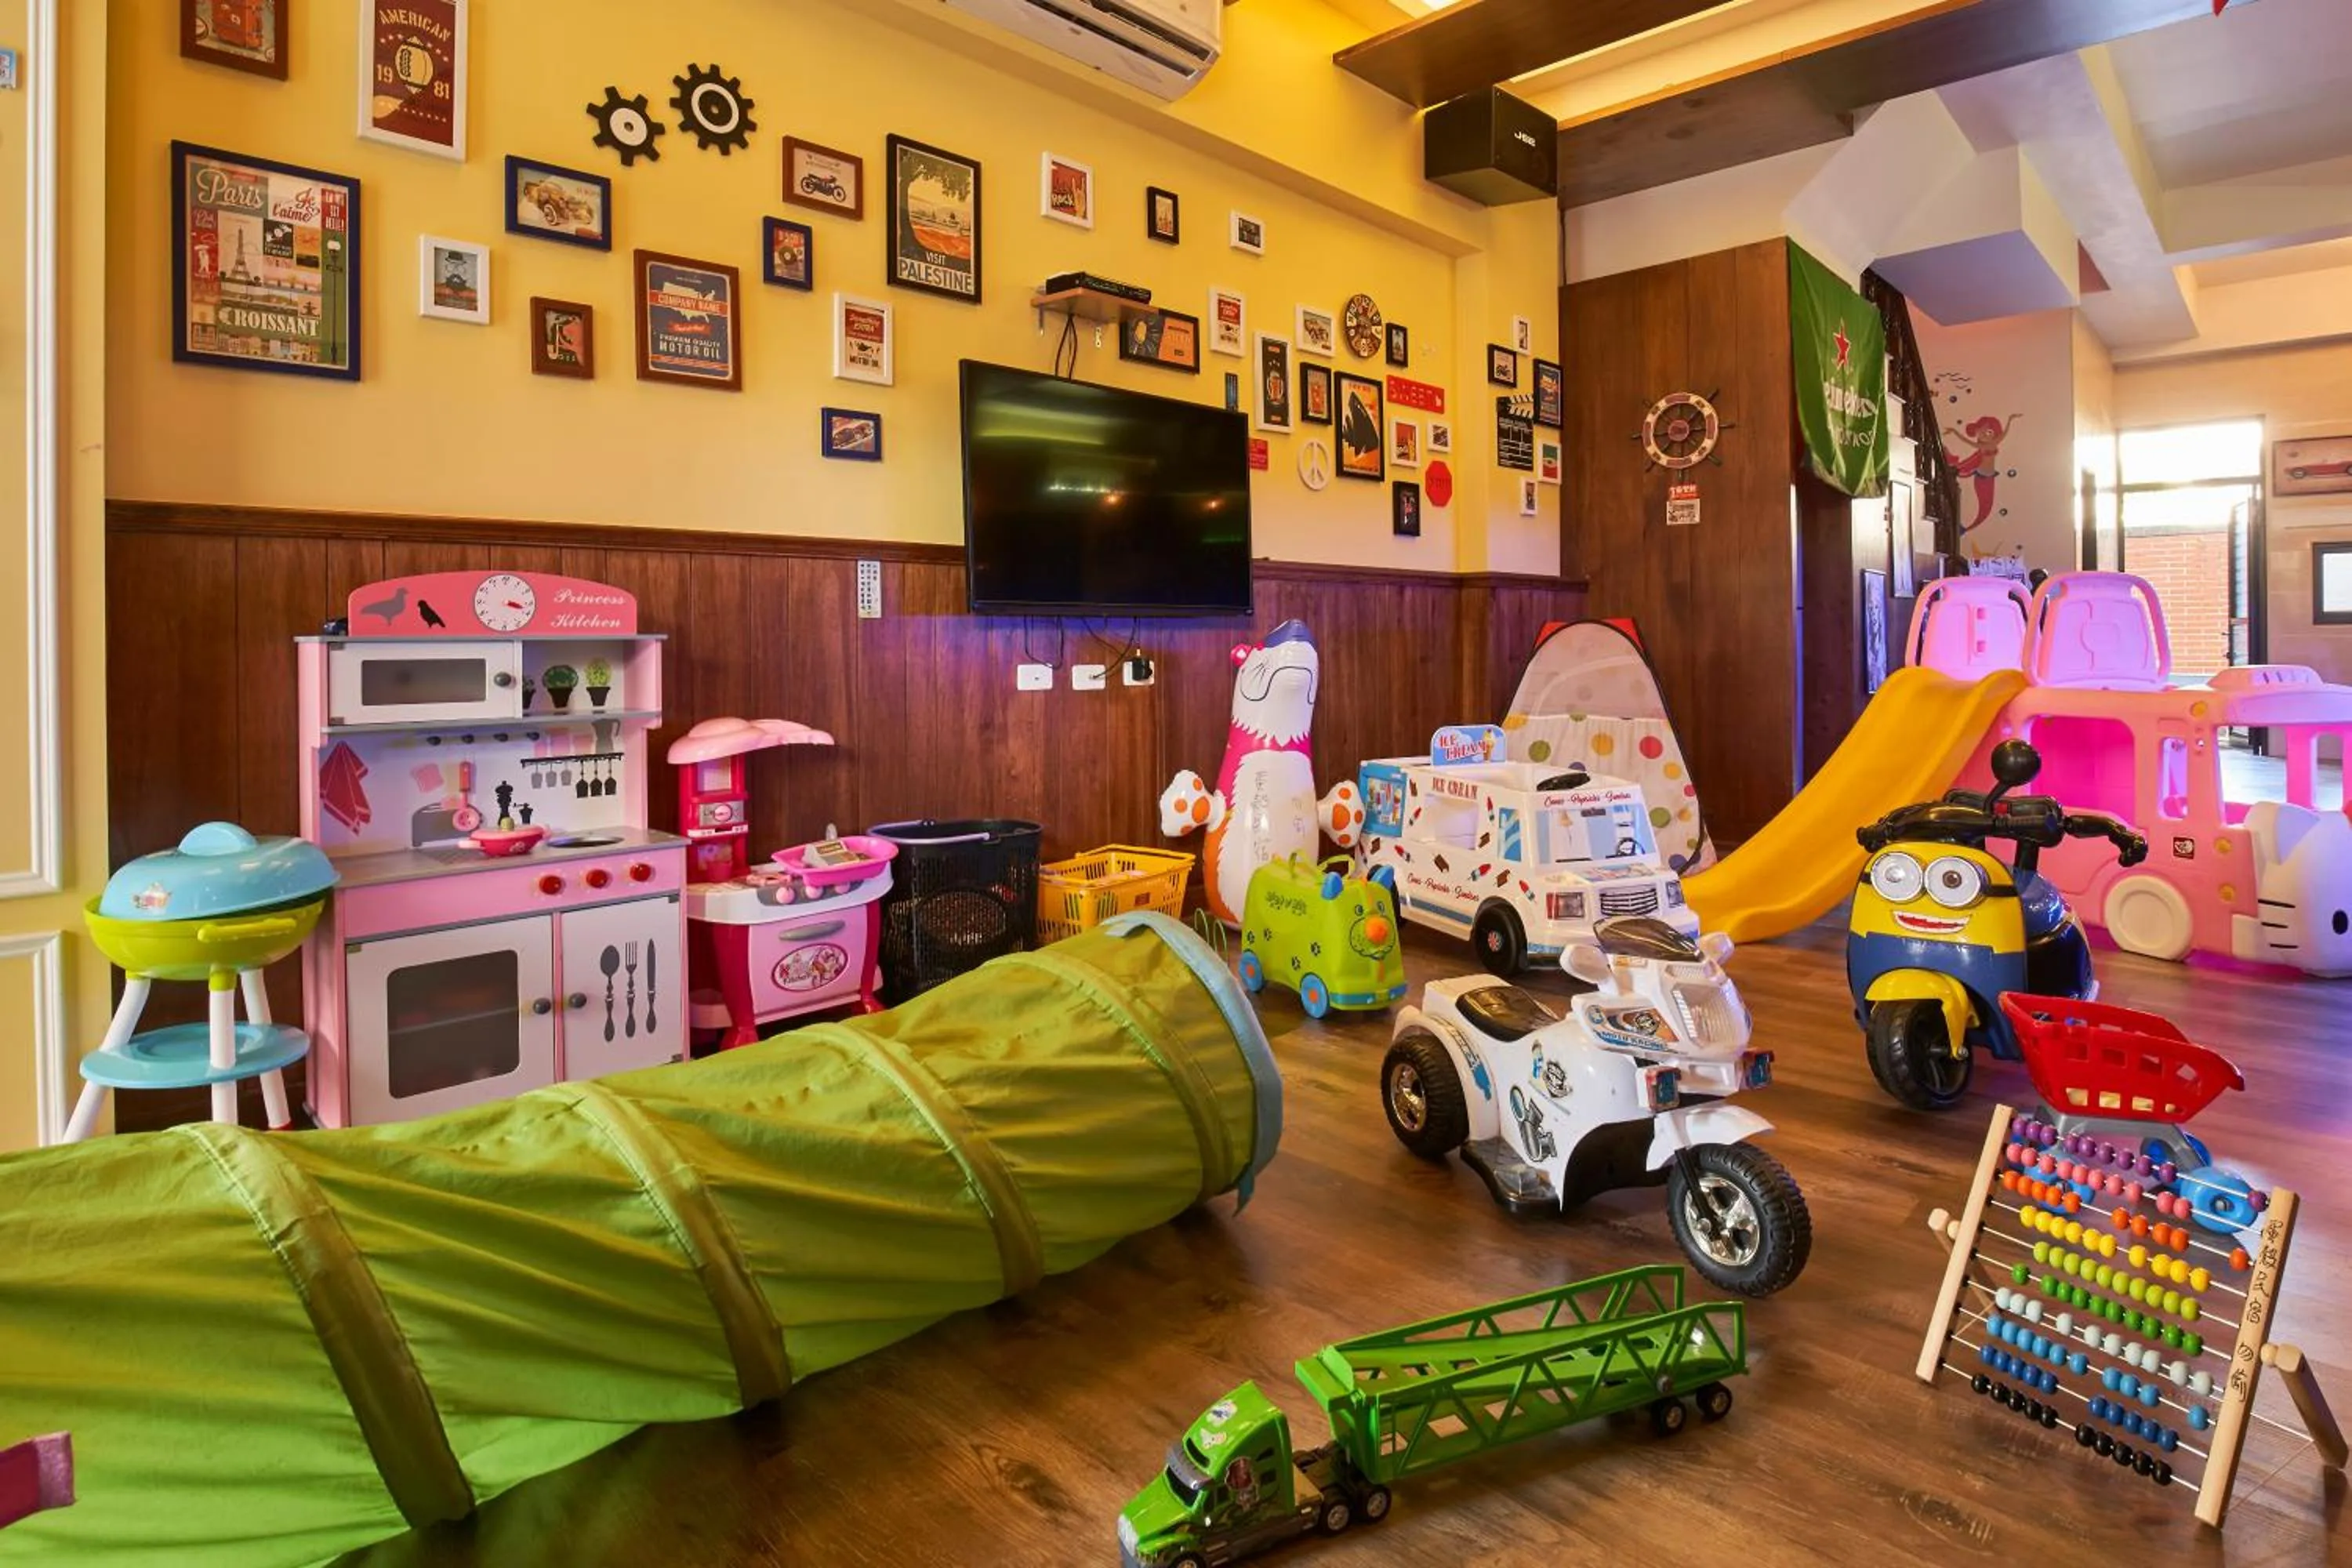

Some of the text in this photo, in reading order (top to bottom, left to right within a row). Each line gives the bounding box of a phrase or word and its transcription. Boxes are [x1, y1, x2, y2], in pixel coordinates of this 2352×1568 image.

[379, 9, 451, 43] AMERICAN
[377, 64, 450, 100] 19 81
[196, 169, 264, 209] Paris
[926, 251, 946, 265] VISIT
[898, 260, 973, 293] PALESTINE
[659, 293, 696, 309] COMPANY
[218, 307, 319, 336] CROISSANT
[659, 340, 720, 359] MOTOR OIL
[554, 588, 626, 604] Princess
[550, 614, 622, 628] Kitchen
[1432, 777, 1478, 800] ICE CREAM
